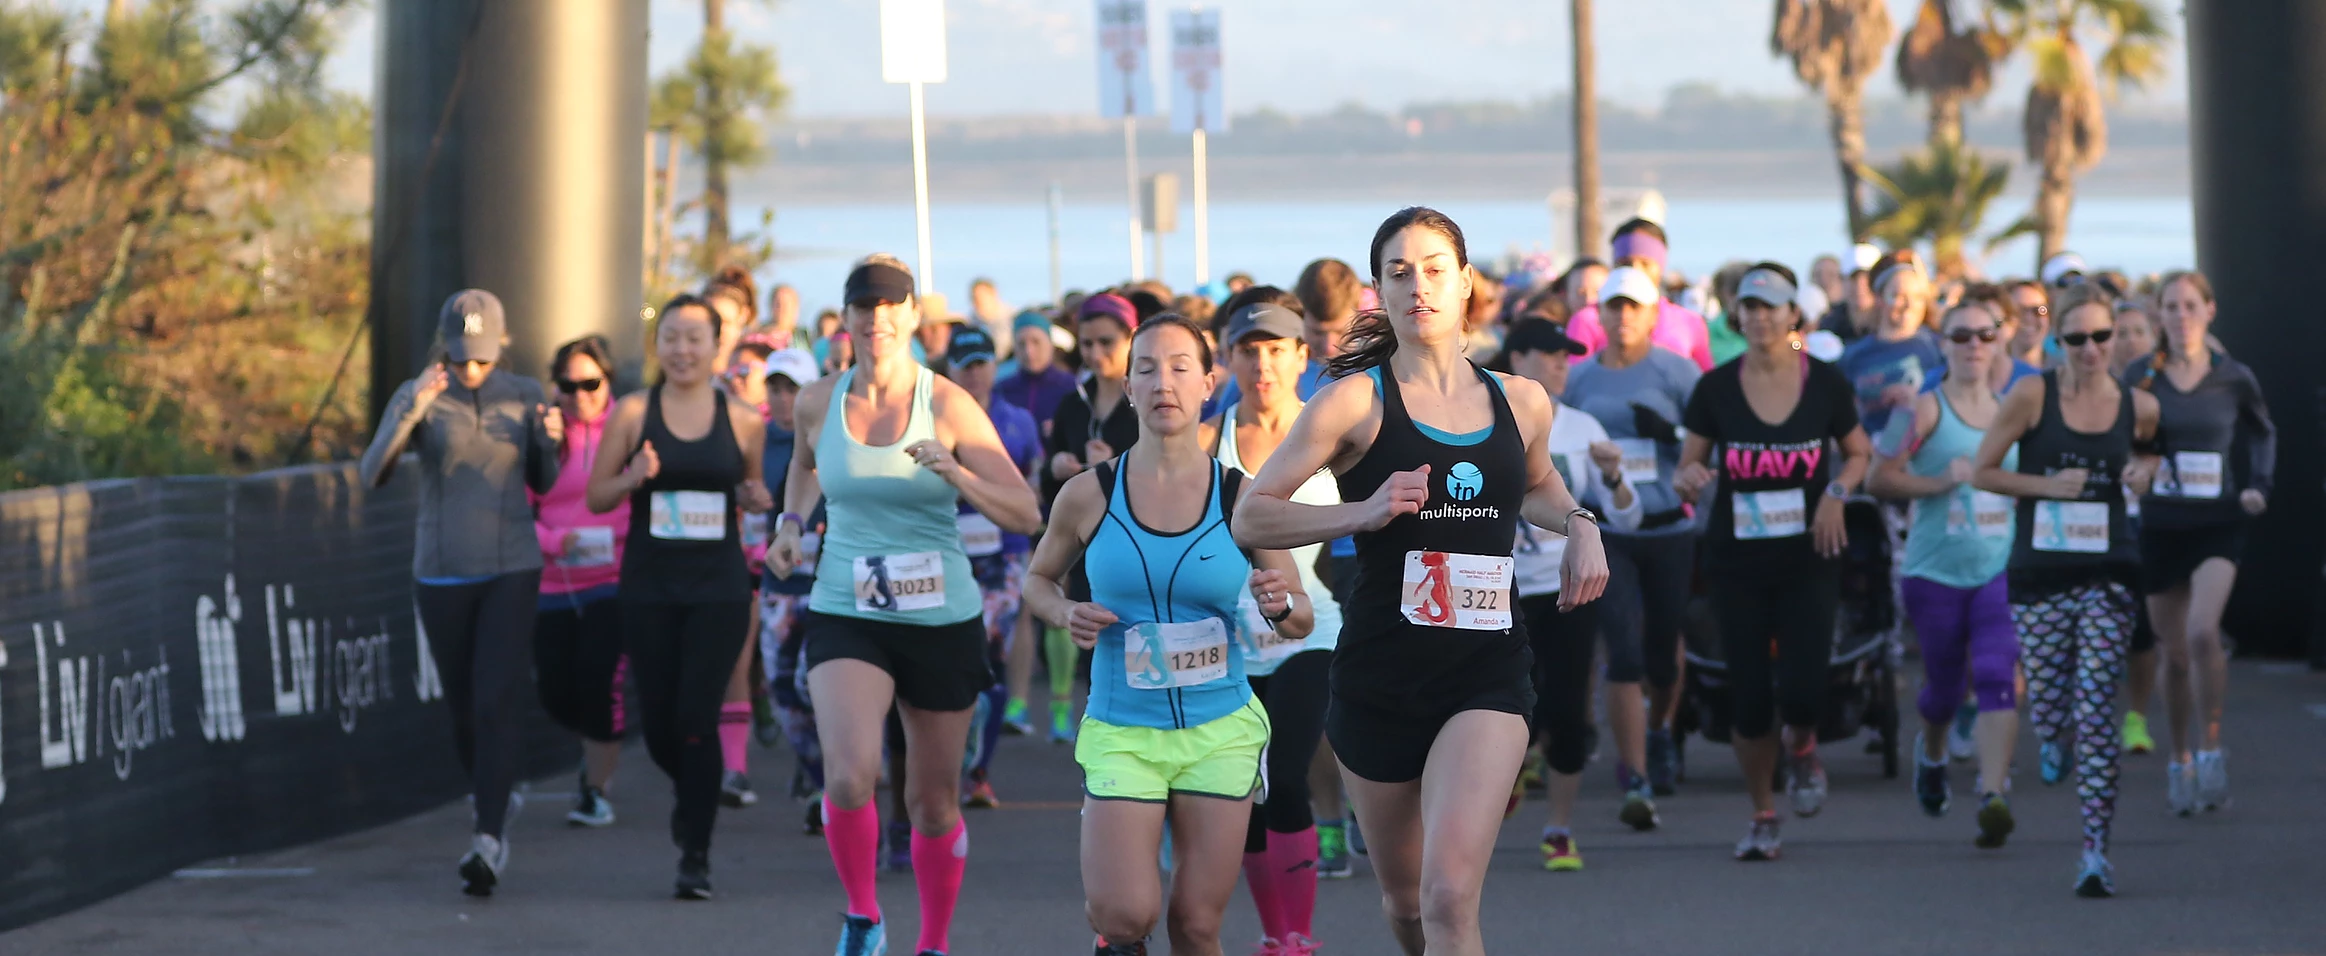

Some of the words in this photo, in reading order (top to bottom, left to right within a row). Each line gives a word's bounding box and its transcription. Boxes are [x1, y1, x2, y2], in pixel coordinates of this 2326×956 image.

[1726, 448, 1821, 479] NAVY
[1454, 482, 1475, 501] tn
[1420, 502, 1499, 521] multisports
[892, 577, 936, 596] 3023
[1461, 588, 1498, 610] 322
[1473, 617, 1499, 626] Amanda
[1172, 647, 1219, 670] 1218
